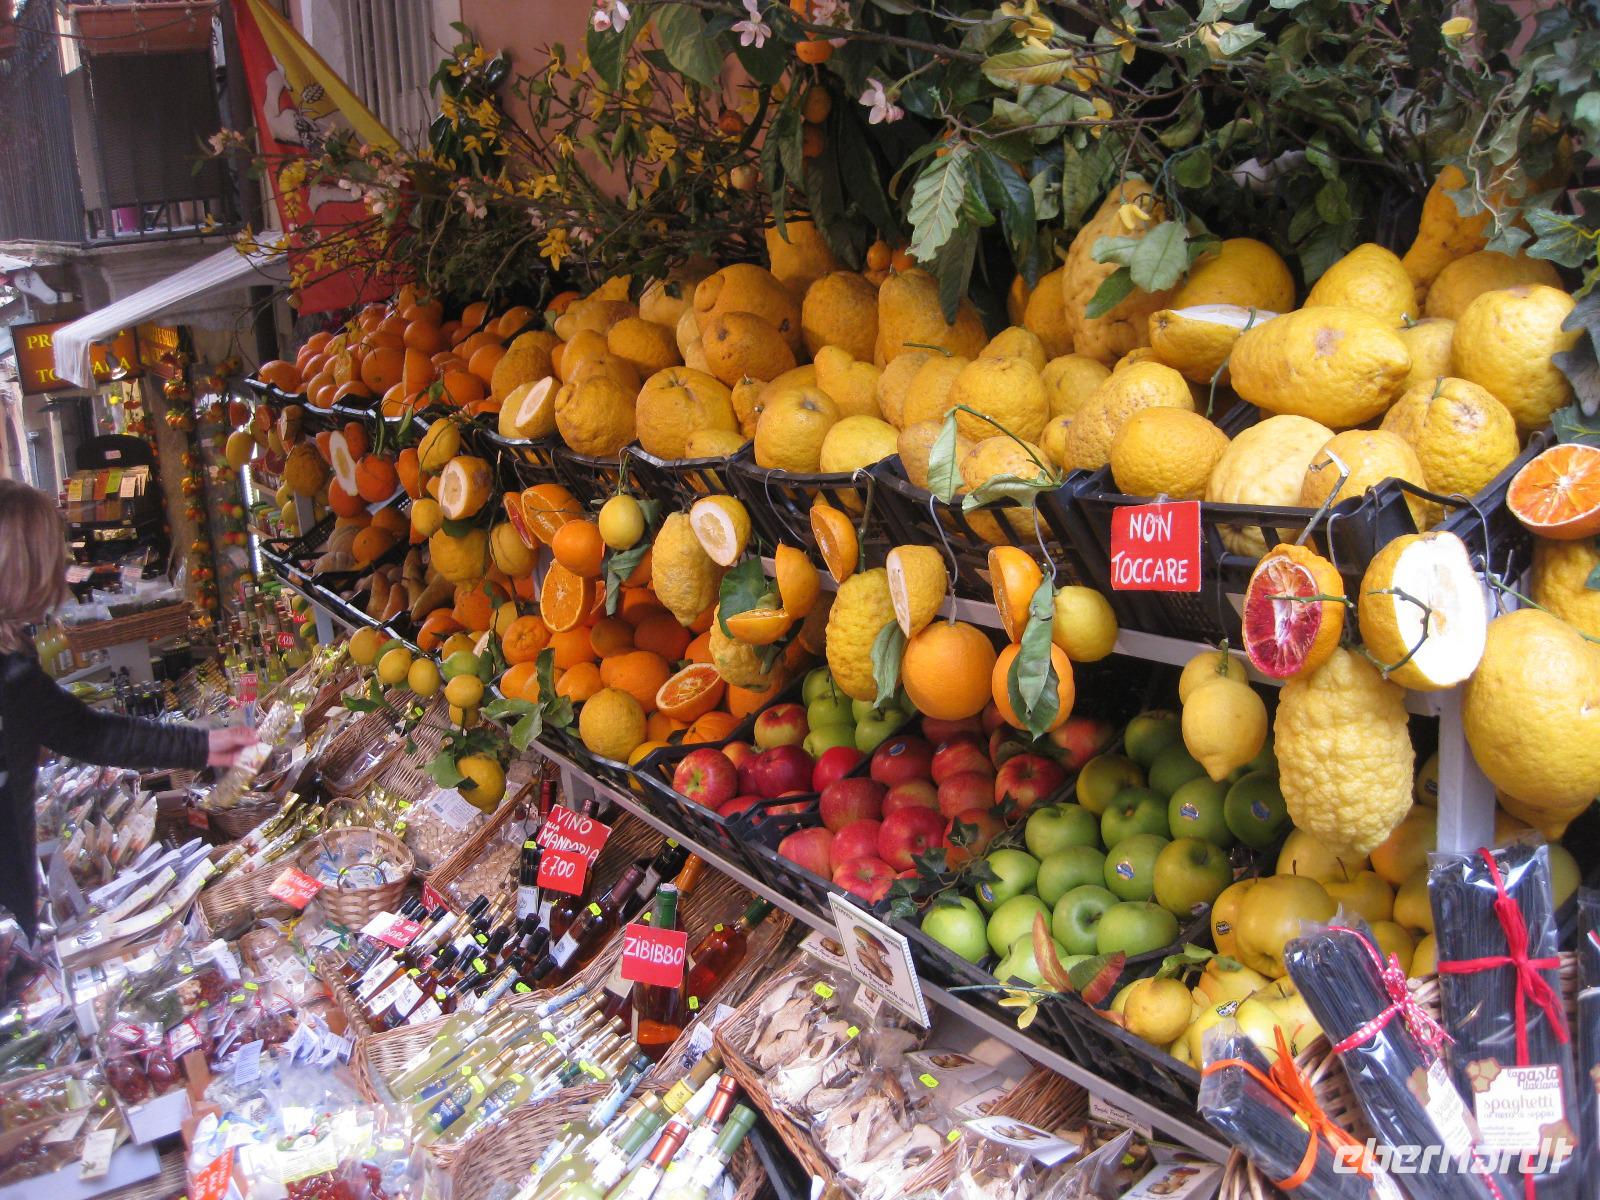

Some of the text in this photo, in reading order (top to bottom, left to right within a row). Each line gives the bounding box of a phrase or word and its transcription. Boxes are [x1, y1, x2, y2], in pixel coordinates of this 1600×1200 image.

[1129, 510, 1172, 543] NON
[1111, 550, 1189, 586] TOCCARE
[545, 821, 560, 832] ALLA
[557, 807, 593, 835] VINO
[623, 935, 684, 965] ZIBIBBO
[1517, 1066, 1558, 1087] pasta
[1483, 1094, 1553, 1114] spaghetti
